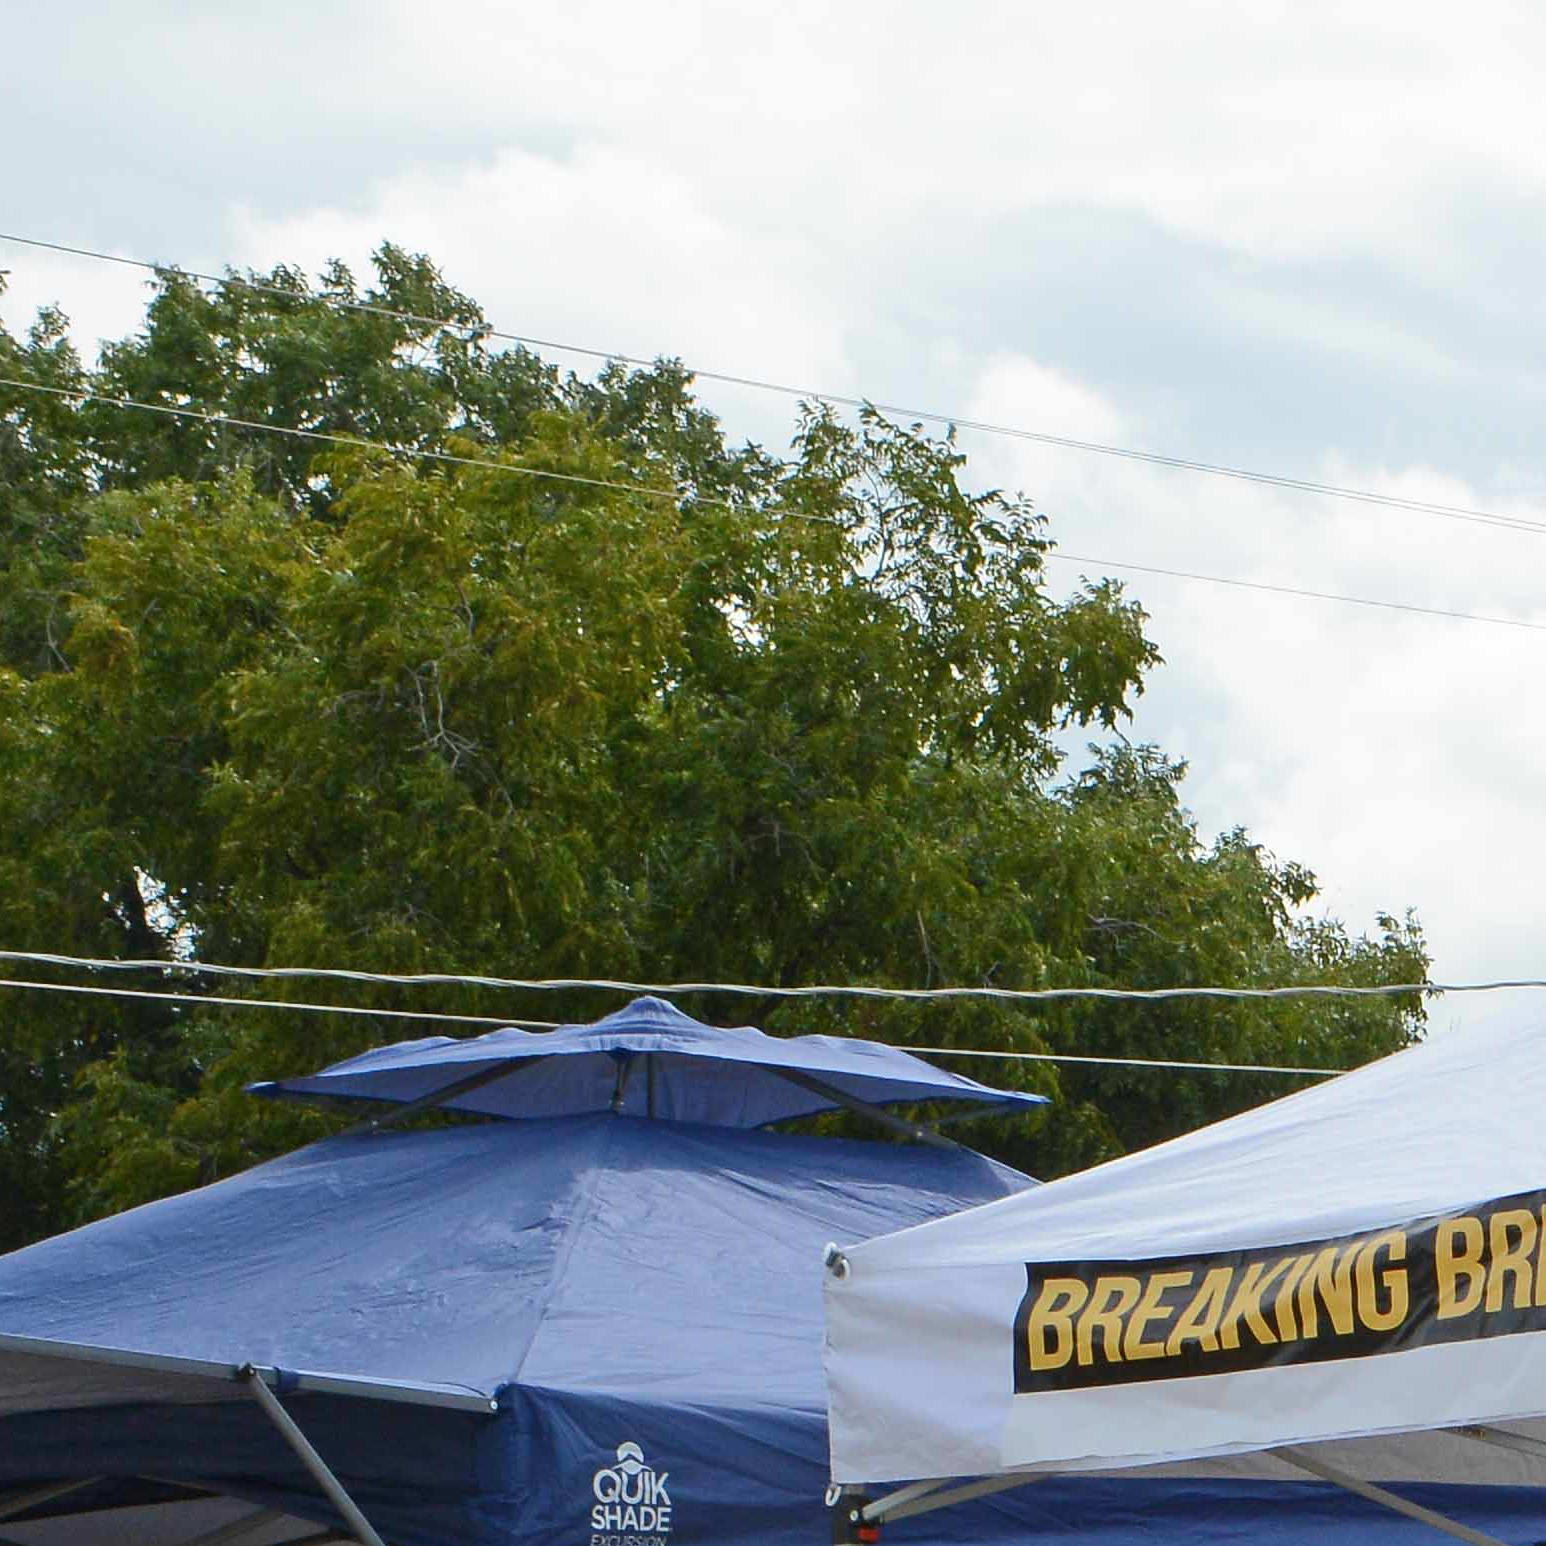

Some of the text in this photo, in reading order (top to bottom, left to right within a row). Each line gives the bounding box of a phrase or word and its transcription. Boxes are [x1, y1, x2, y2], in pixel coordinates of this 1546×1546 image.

[1028, 1230, 1409, 1371] BREAKING
[593, 1469, 671, 1505] QUIK
[591, 1505, 672, 1532] SHADE
